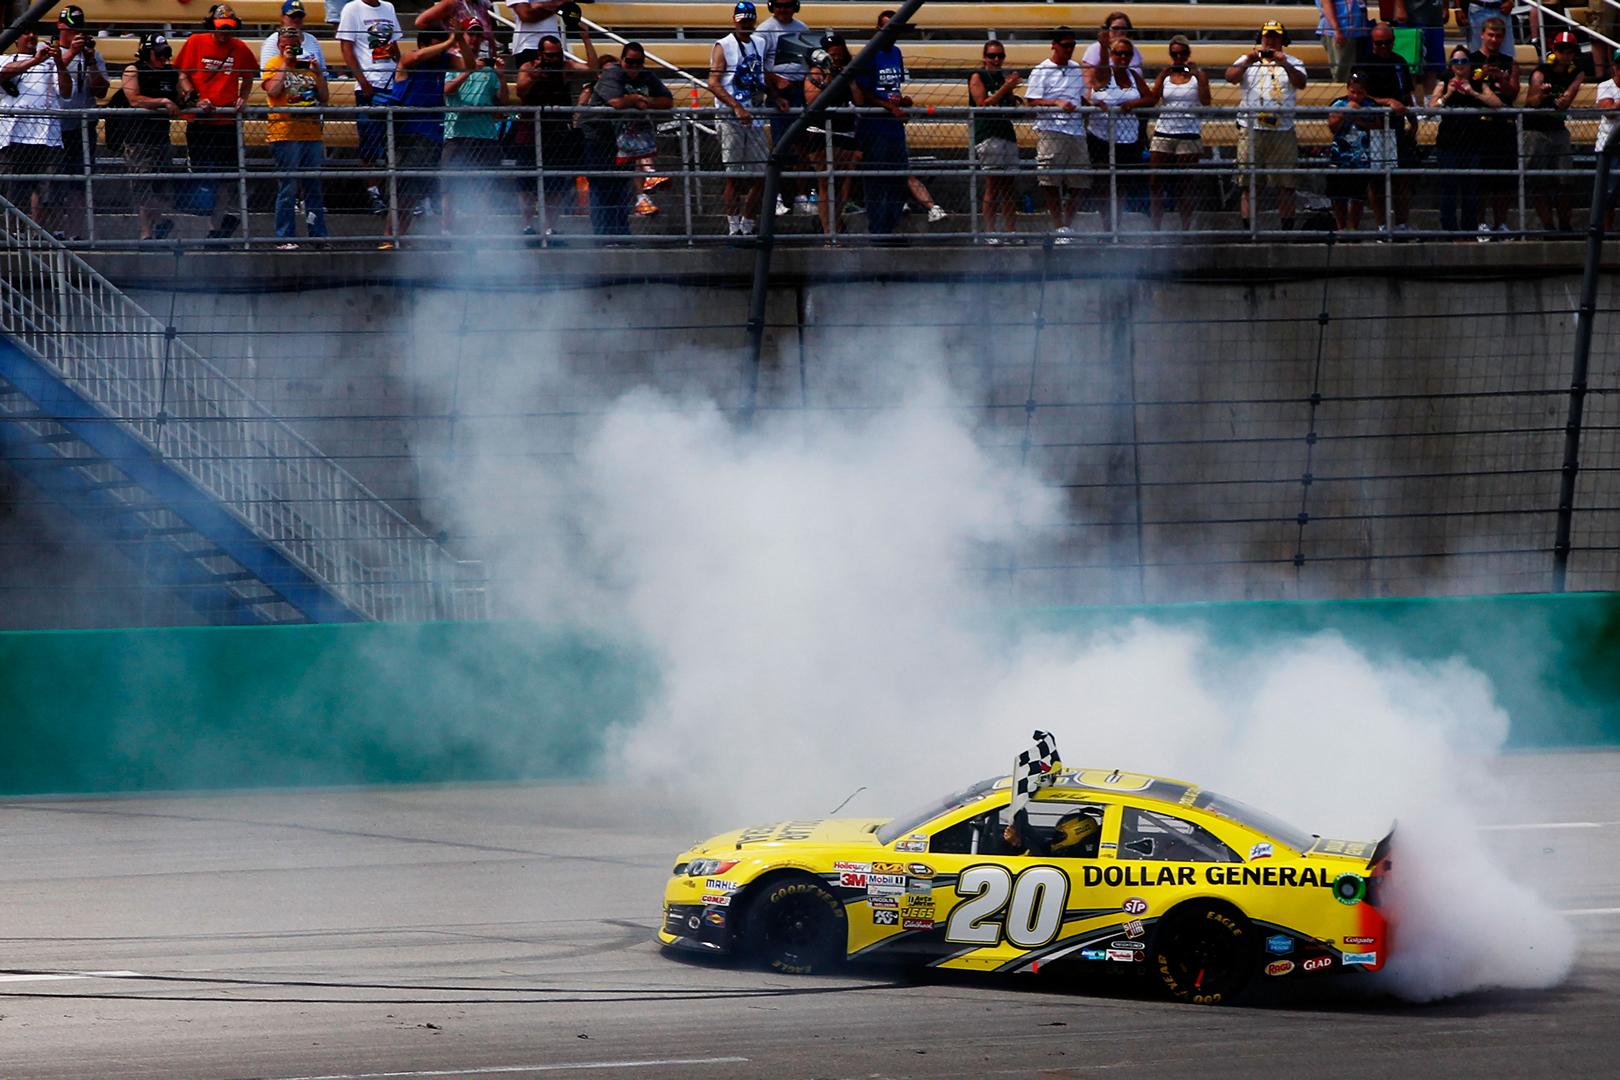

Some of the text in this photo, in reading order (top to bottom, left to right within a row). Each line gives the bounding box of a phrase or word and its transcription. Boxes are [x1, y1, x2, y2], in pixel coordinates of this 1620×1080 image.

[841, 873, 866, 887] 3M
[869, 875, 893, 884] Mobil
[1083, 865, 1196, 886] DOLLAR
[1205, 866, 1335, 888] GENERAL
[706, 879, 737, 889] MAHLE
[904, 907, 933, 918] JEGS
[945, 863, 1071, 949] 20
[1124, 900, 1147, 913] STP
[1206, 911, 1242, 937] EAGLE
[1345, 936, 1375, 944] Colgate
[1303, 957, 1332, 971] GLAD
